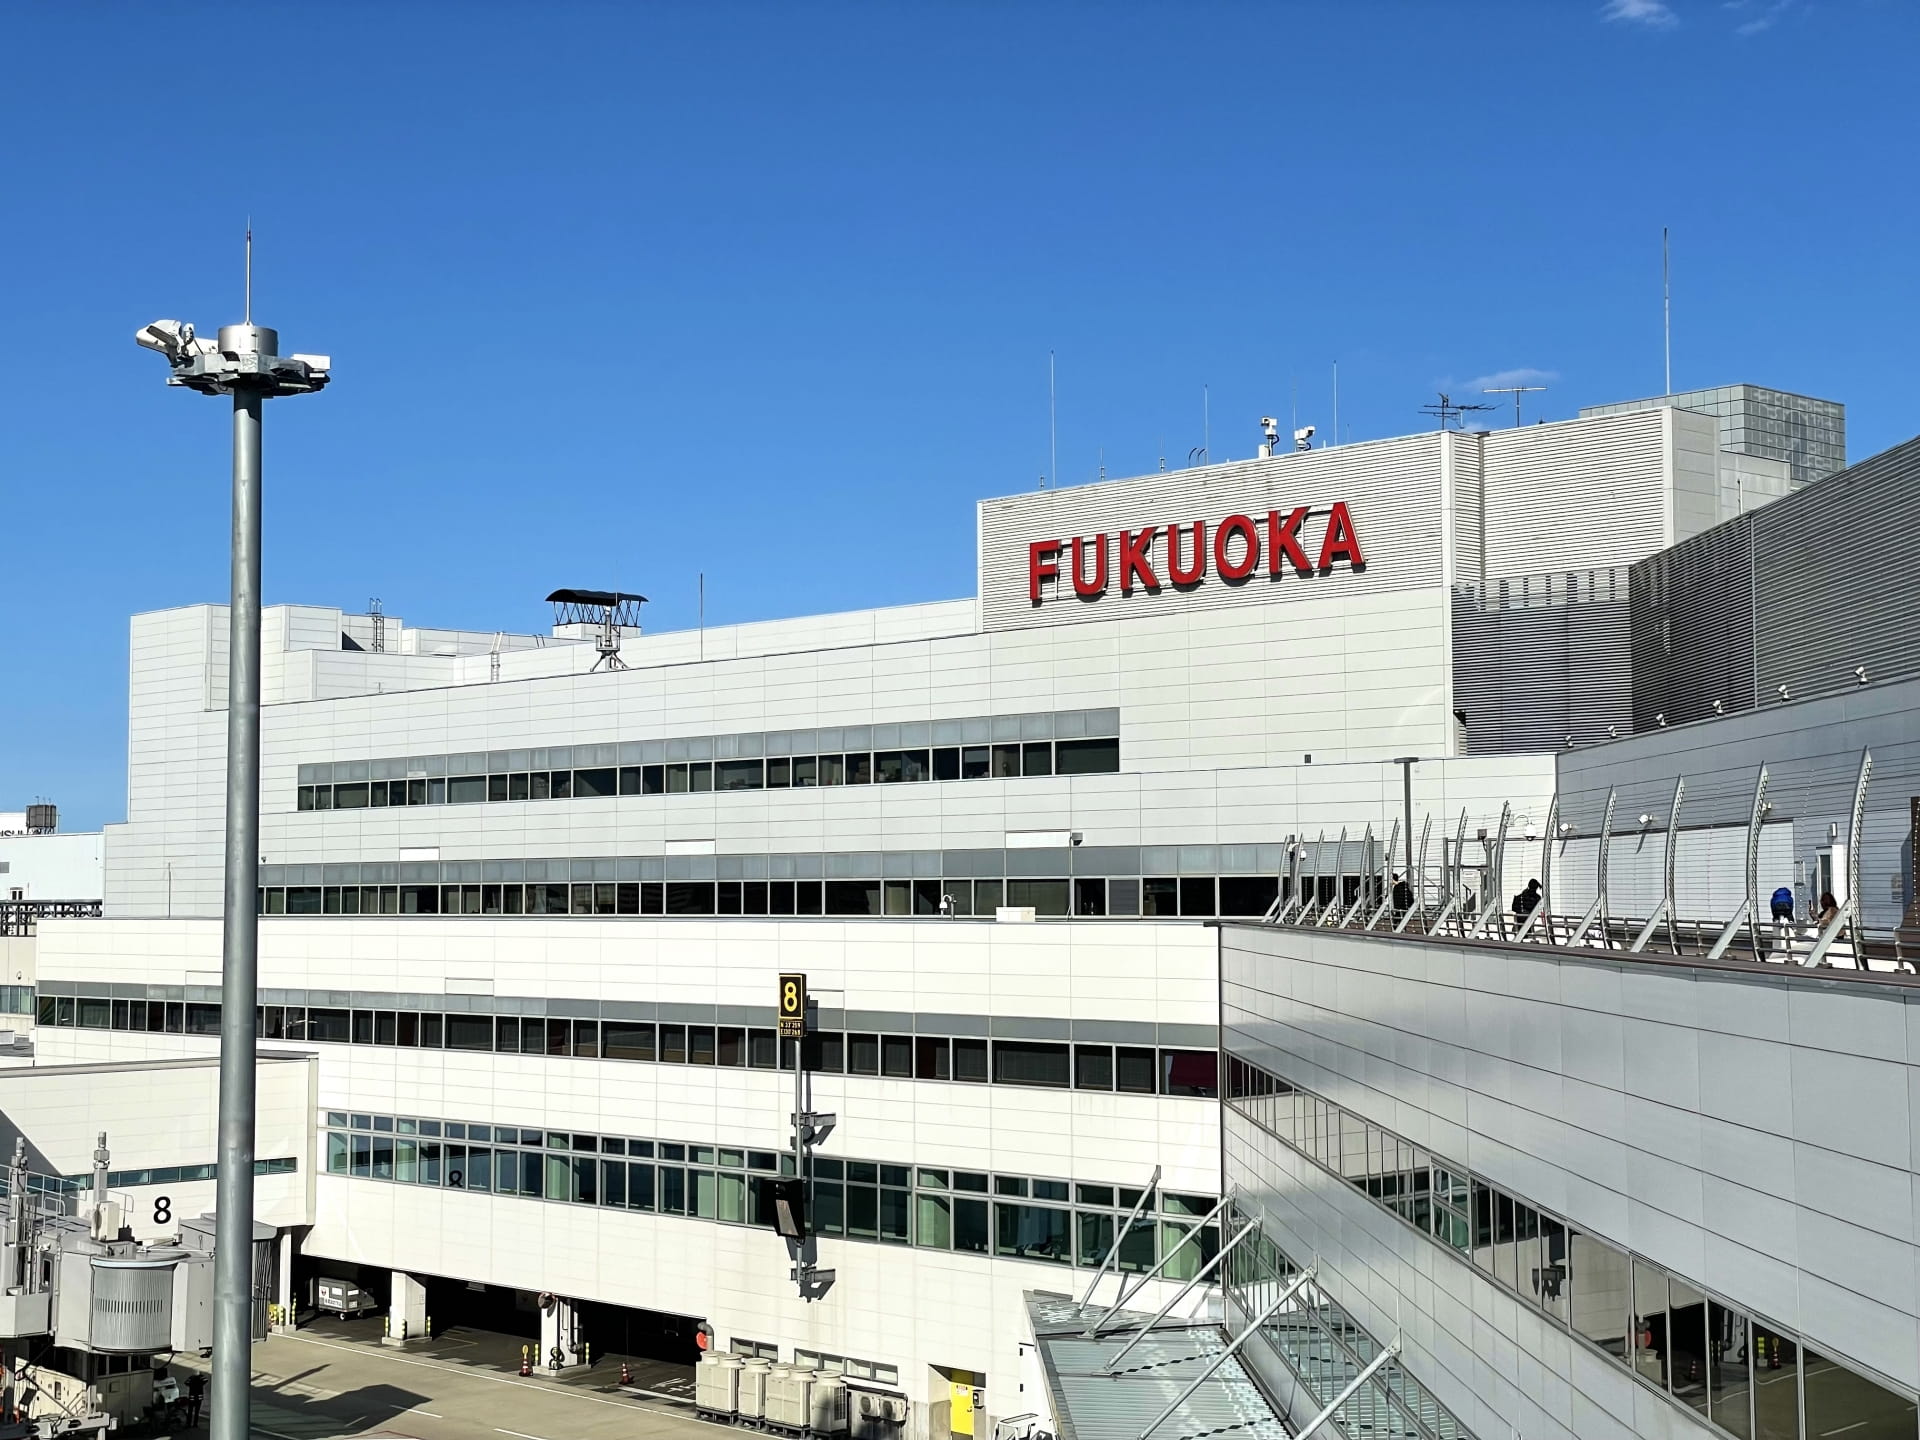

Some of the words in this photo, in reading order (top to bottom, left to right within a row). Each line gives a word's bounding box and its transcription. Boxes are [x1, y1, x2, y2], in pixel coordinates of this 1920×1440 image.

[1029, 501, 1365, 601] FUKUOKA
[784, 982, 797, 1012] 8
[152, 1195, 172, 1224] 8
